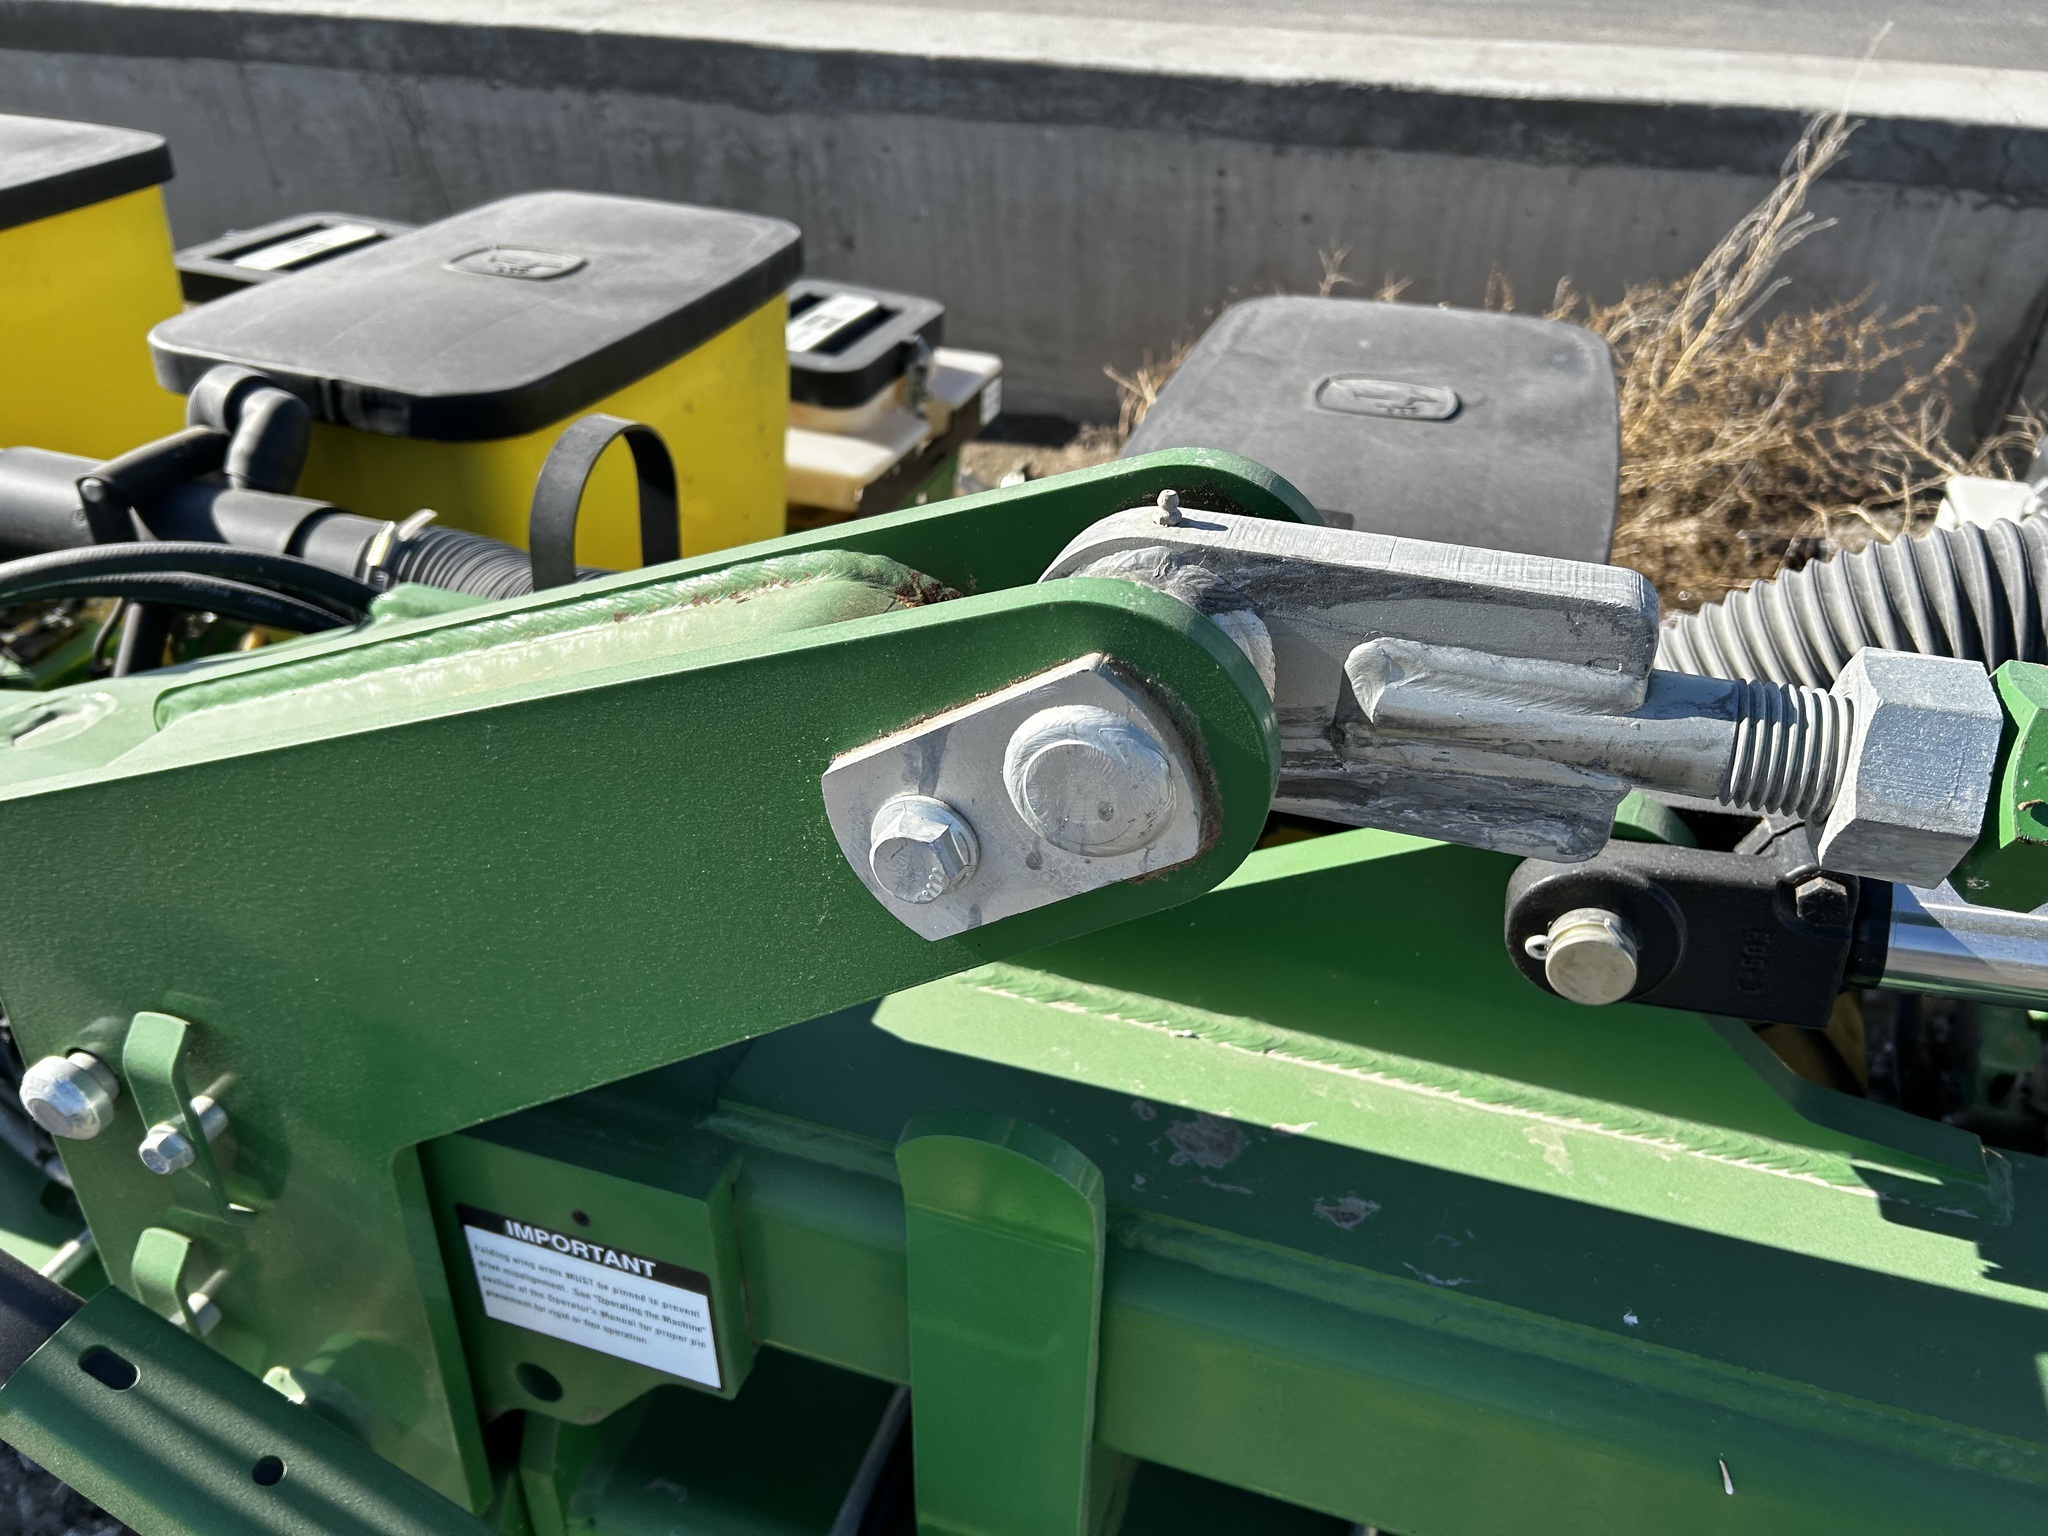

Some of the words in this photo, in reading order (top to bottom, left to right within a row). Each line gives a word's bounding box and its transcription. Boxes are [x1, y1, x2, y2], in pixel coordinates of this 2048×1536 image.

[505, 1220, 656, 1277] IMPORTANT
[529, 1288, 544, 1298] the
[600, 1311, 636, 1326] Manual
[655, 1328, 686, 1342] proper
[690, 1338, 706, 1349] pin
[565, 1273, 593, 1285] MUST
[597, 1281, 608, 1291] be
[611, 1287, 646, 1301] pinned
[661, 1302, 699, 1317] prevent
[645, 1310, 658, 1320] the
